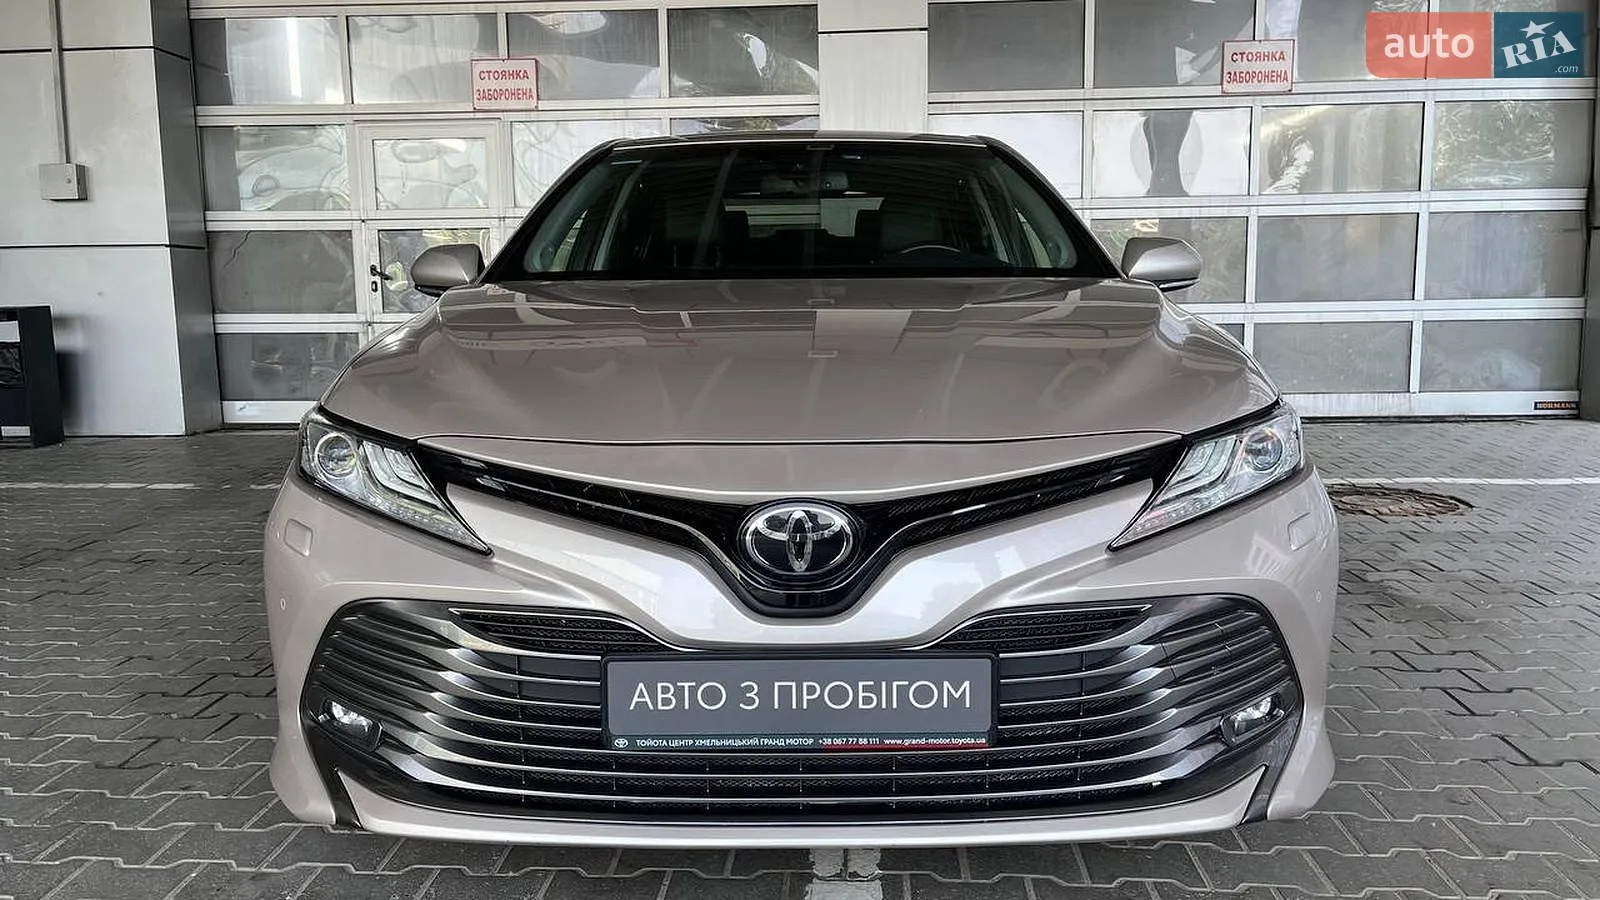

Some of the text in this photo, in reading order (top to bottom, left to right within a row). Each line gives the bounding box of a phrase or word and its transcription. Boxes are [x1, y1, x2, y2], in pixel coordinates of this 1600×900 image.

[1231, 51, 1286, 63] СТОЯНКА
[479, 70, 529, 80] СТОЯНКА
[1226, 70, 1288, 84] ЗАБОРОНЕНА
[476, 88, 534, 101] ЗАБОРОНЕНА
[629, 680, 971, 710] АВТО З ПРОБІГОМ
[636, 738, 668, 746] ТОЙОТА
[669, 738, 693, 747] ЦЕНТР
[694, 737, 759, 746] ХМЕЛЬНИЦЬКИЙ
[760, 738, 785, 746] ГРАНД
[786, 738, 814, 746] МОТОР
[884, 737, 986, 746] www.grand-motor.toyota.ua
